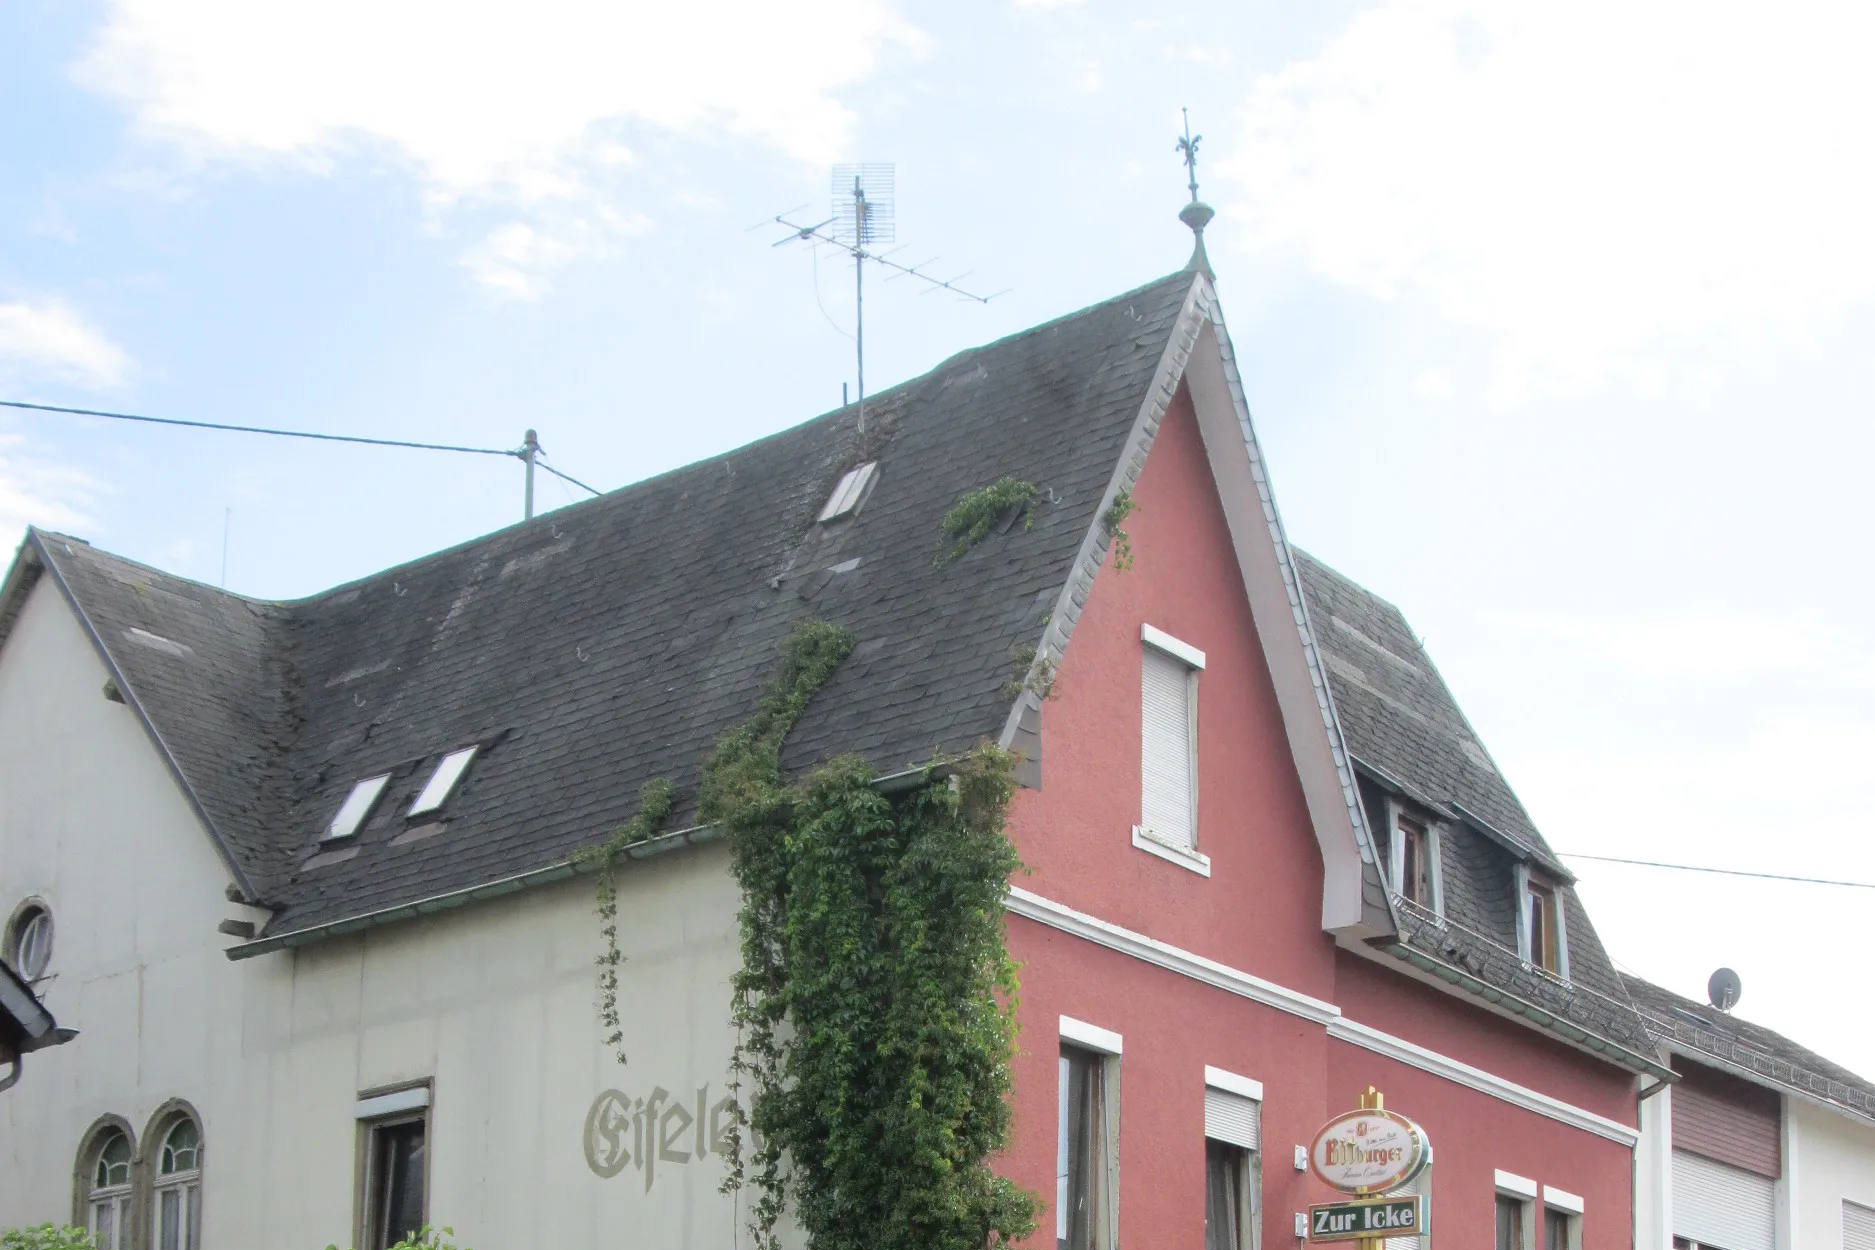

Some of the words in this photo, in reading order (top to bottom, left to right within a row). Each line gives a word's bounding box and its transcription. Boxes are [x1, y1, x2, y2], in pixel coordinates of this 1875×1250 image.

[1324, 1136, 1403, 1166] Bitburger
[1314, 1211, 1356, 1234] Zur
[1365, 1205, 1414, 1229] Icke
